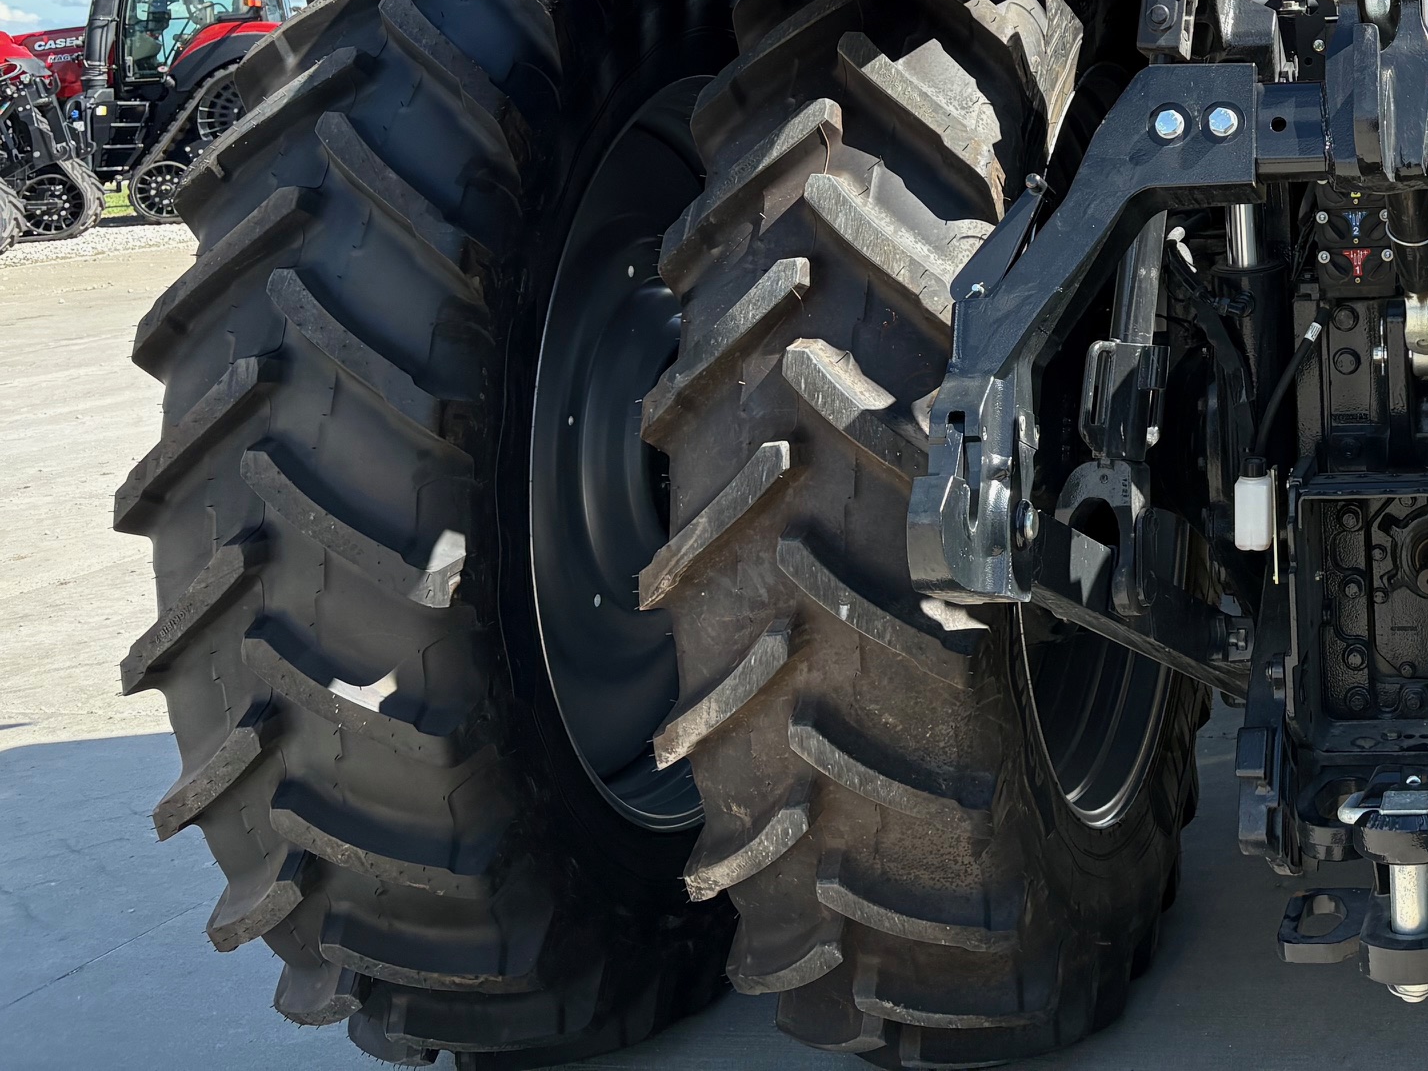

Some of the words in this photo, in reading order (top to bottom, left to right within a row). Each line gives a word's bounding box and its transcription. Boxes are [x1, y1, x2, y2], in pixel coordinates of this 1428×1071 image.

[34, 37, 76, 50] CASE
[1353, 226, 1359, 235] 2
[1355, 266, 1360, 274] 1
